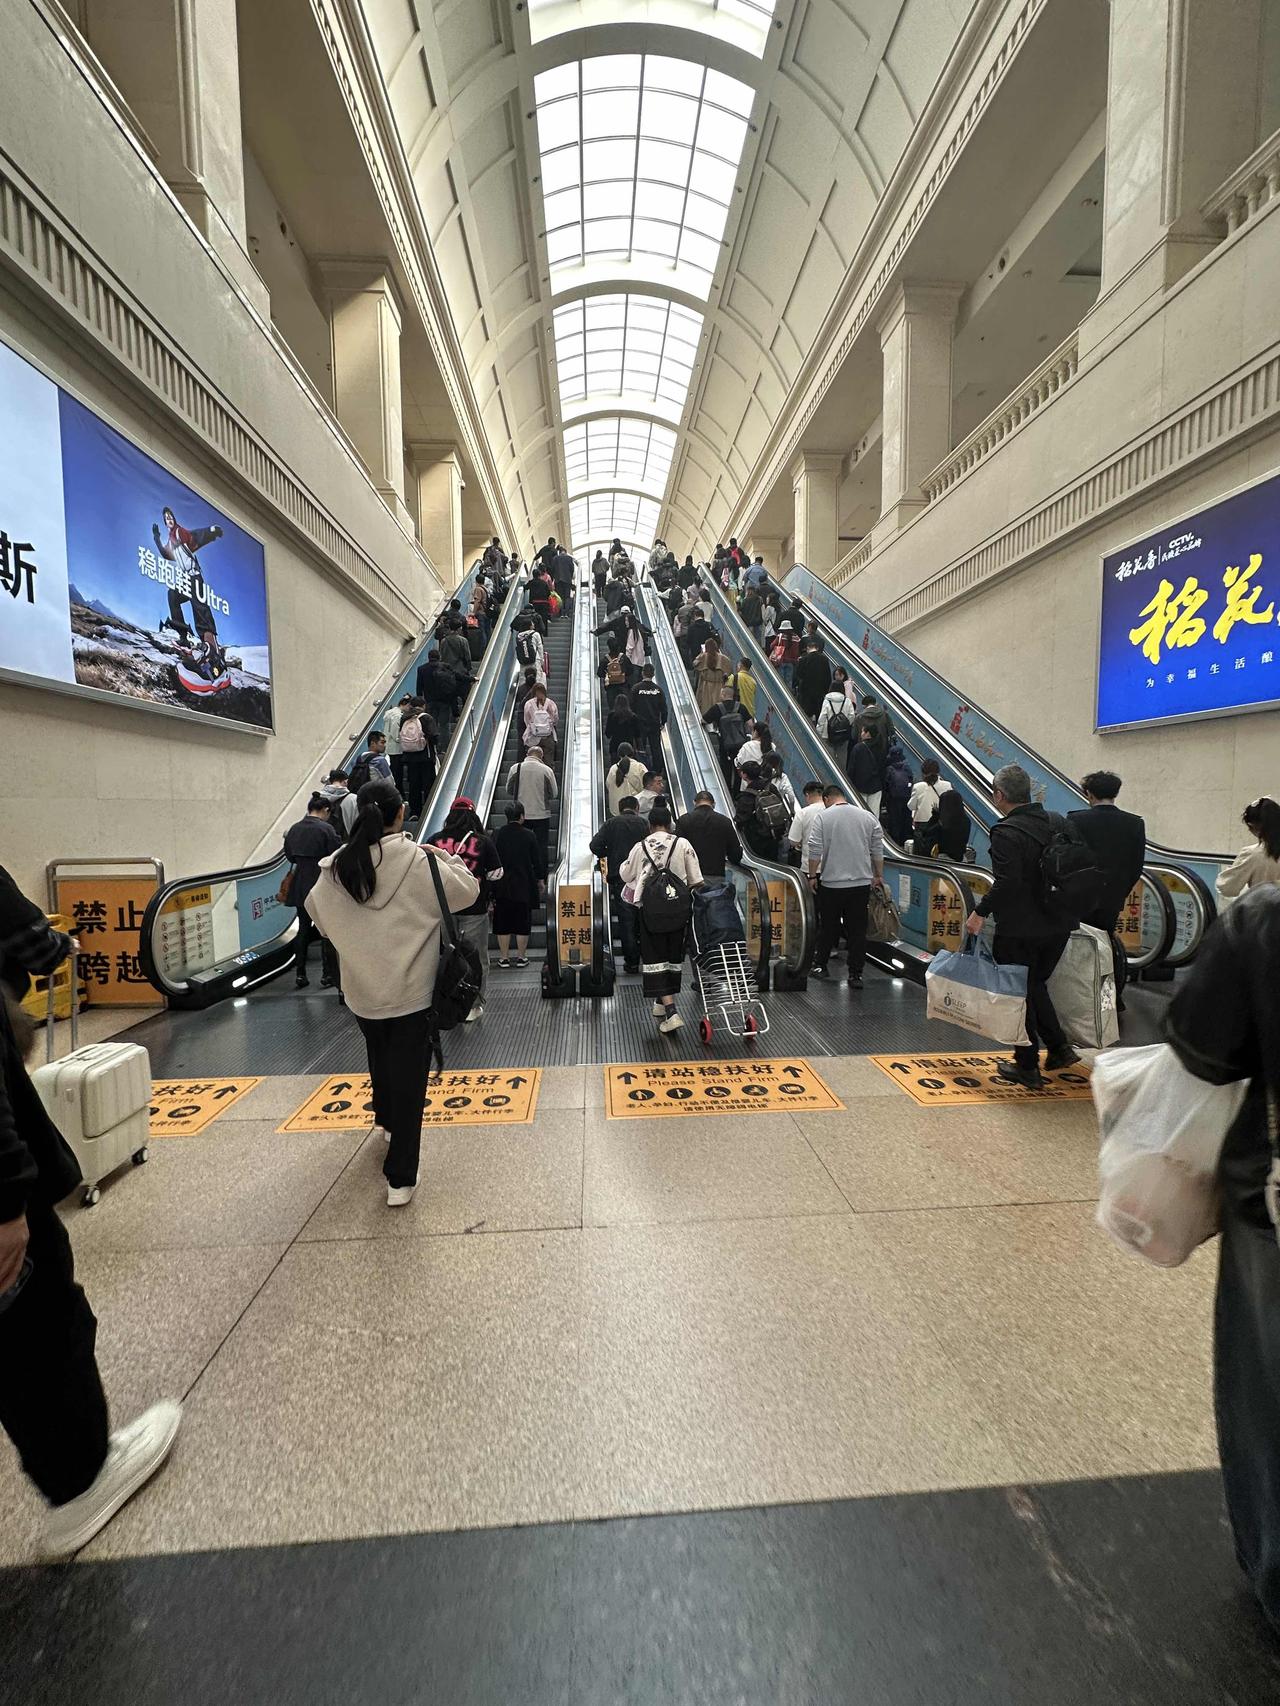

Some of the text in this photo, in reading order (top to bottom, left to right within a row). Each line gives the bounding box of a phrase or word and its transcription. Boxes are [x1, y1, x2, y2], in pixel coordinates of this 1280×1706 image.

[0, 530, 37, 604] 斯
[138, 546, 230, 615] 稳跑鞋 Ultra
[1129, 554, 1280, 665] 稻花
[1145, 651, 1273, 689] 为幸福生活酿
[561, 900, 591, 918] 禁止
[932, 894, 961, 911] 禁止
[72, 900, 144, 934] 禁止
[562, 928, 592, 945] 跨越
[931, 920, 961, 937] 跨越
[77, 950, 150, 985] 跨越
[911, 1056, 1015, 1069] 请站稳扶
[643, 1064, 775, 1079] 请站稳扶好
[647, 1075, 780, 1087] Please Stand Firm
[152, 1083, 216, 1097] 扶好
[462, 1086, 495, 1095] Firm
